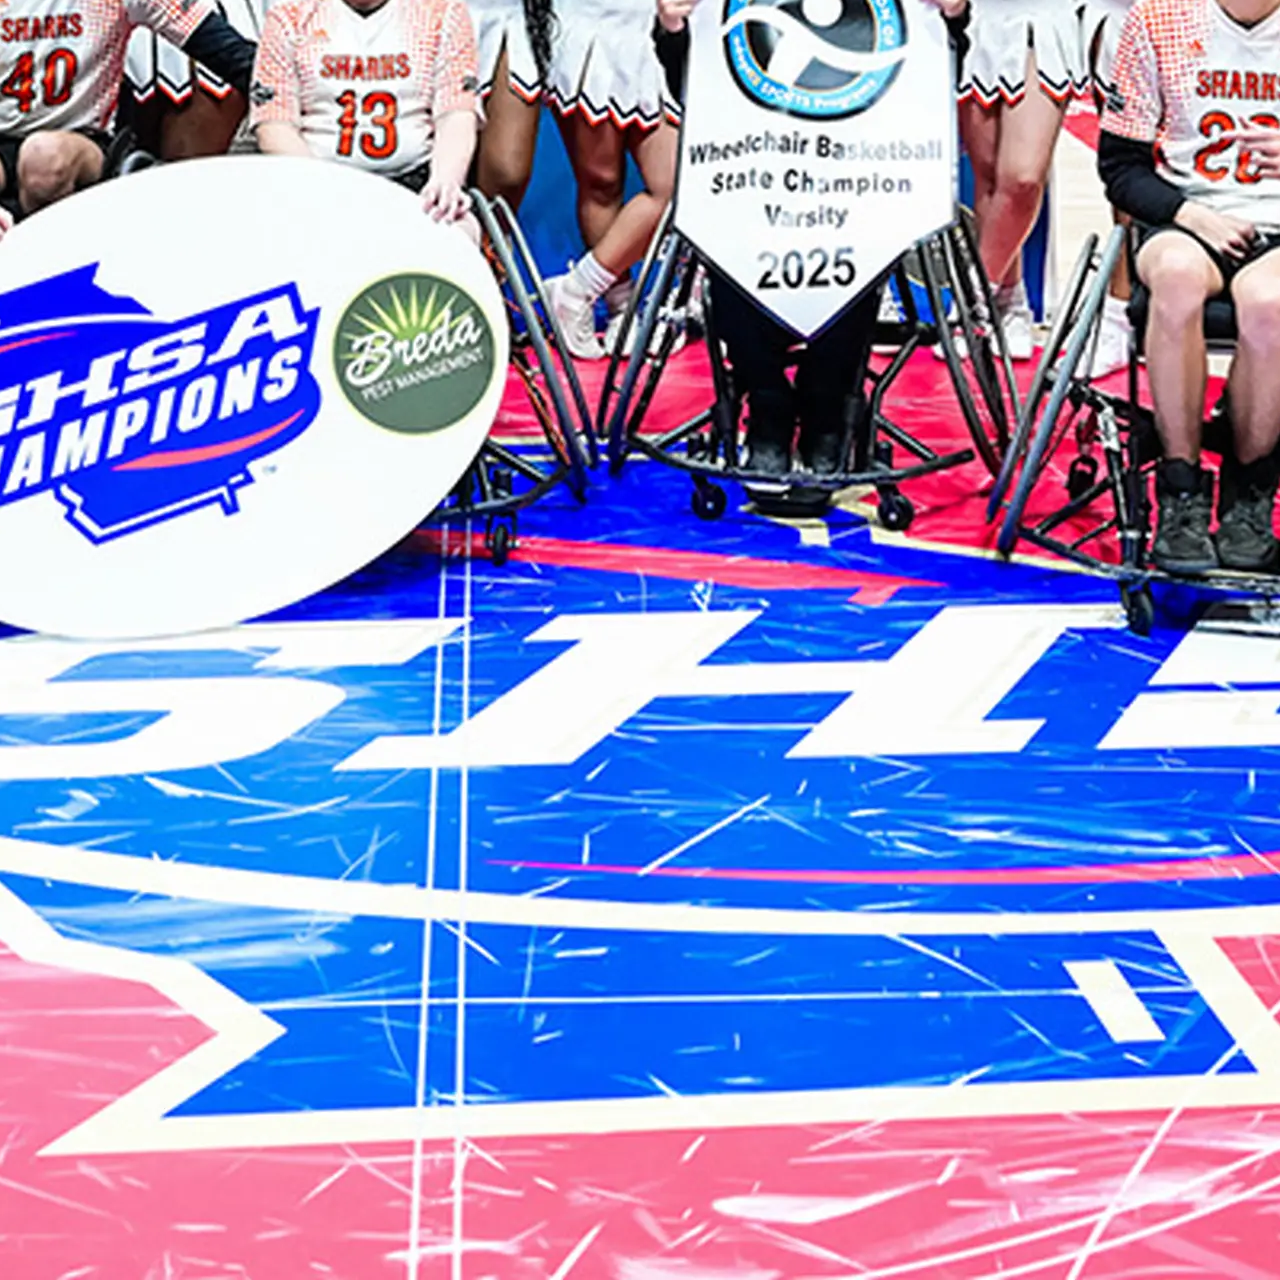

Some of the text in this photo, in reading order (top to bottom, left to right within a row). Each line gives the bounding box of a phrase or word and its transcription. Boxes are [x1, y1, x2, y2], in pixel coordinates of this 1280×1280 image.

[0, 13, 84, 43] SHARKS
[0, 47, 78, 114] 40
[318, 52, 411, 83] SHARKS
[336, 89, 398, 161] 13
[688, 130, 943, 166] Wheelchair Basketball
[710, 167, 913, 196] State Champion
[763, 203, 849, 229] Varsity
[756, 246, 857, 290] 2025
[345, 307, 484, 387] Breda
[359, 345, 485, 403] PEST MANAGEMENT
